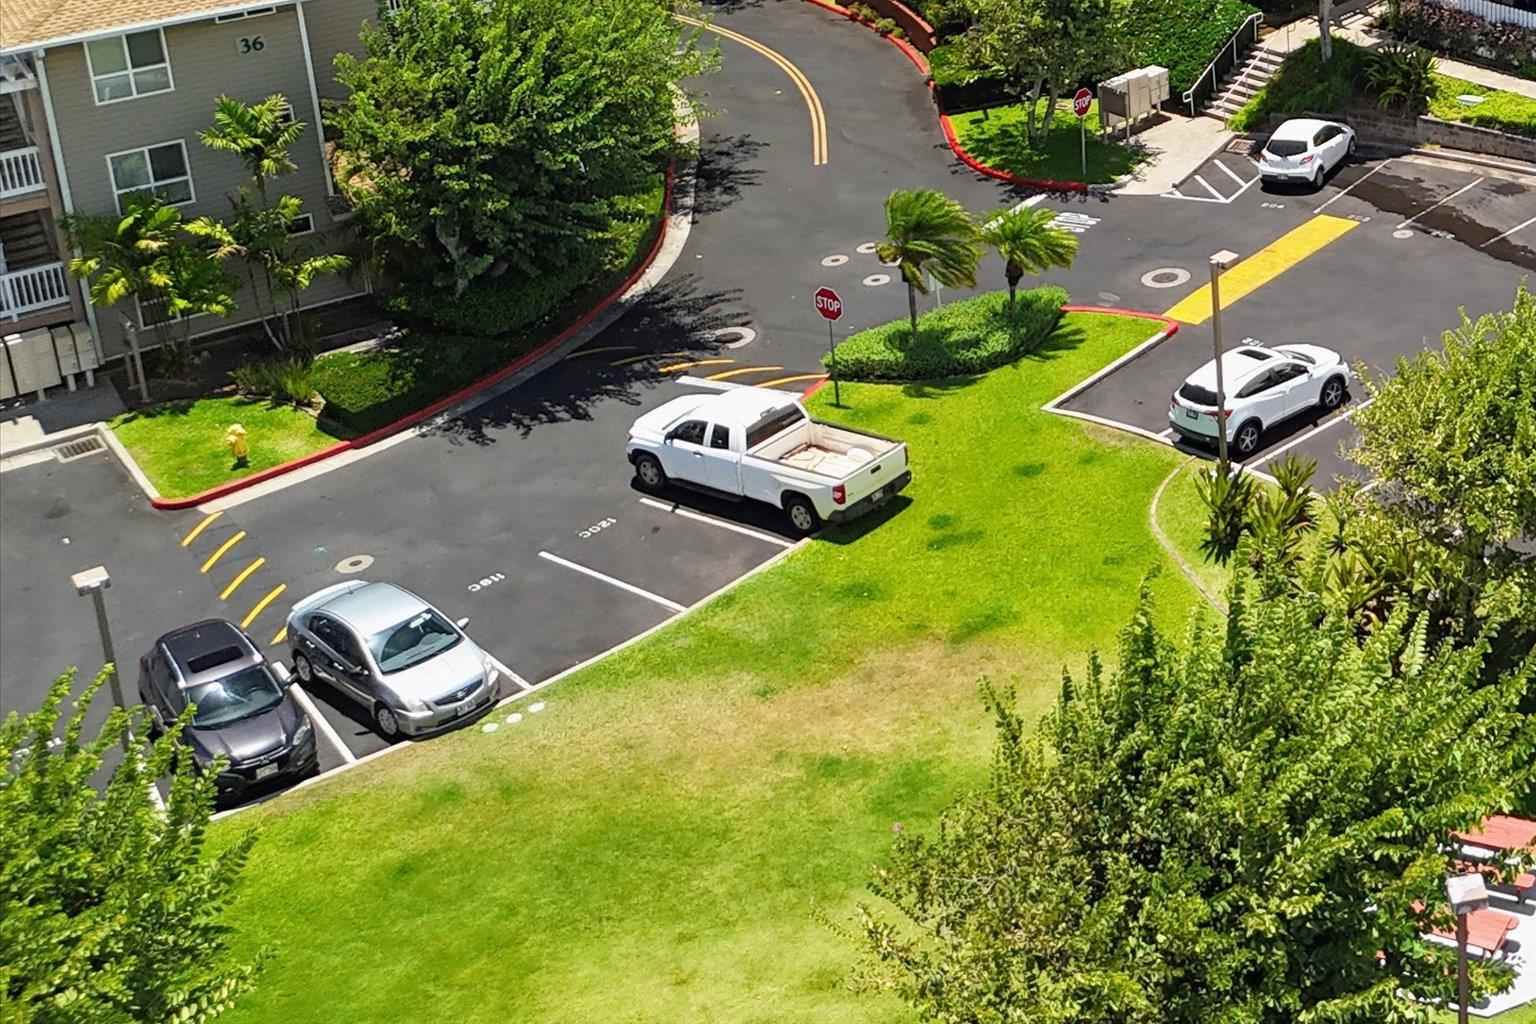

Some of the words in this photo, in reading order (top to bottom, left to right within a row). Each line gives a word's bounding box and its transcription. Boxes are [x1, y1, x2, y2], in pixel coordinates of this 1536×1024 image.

[239, 35, 265, 55] 36
[1074, 94, 1092, 111] STOP
[816, 295, 841, 313] STOP
[578, 517, 617, 538] 120C
